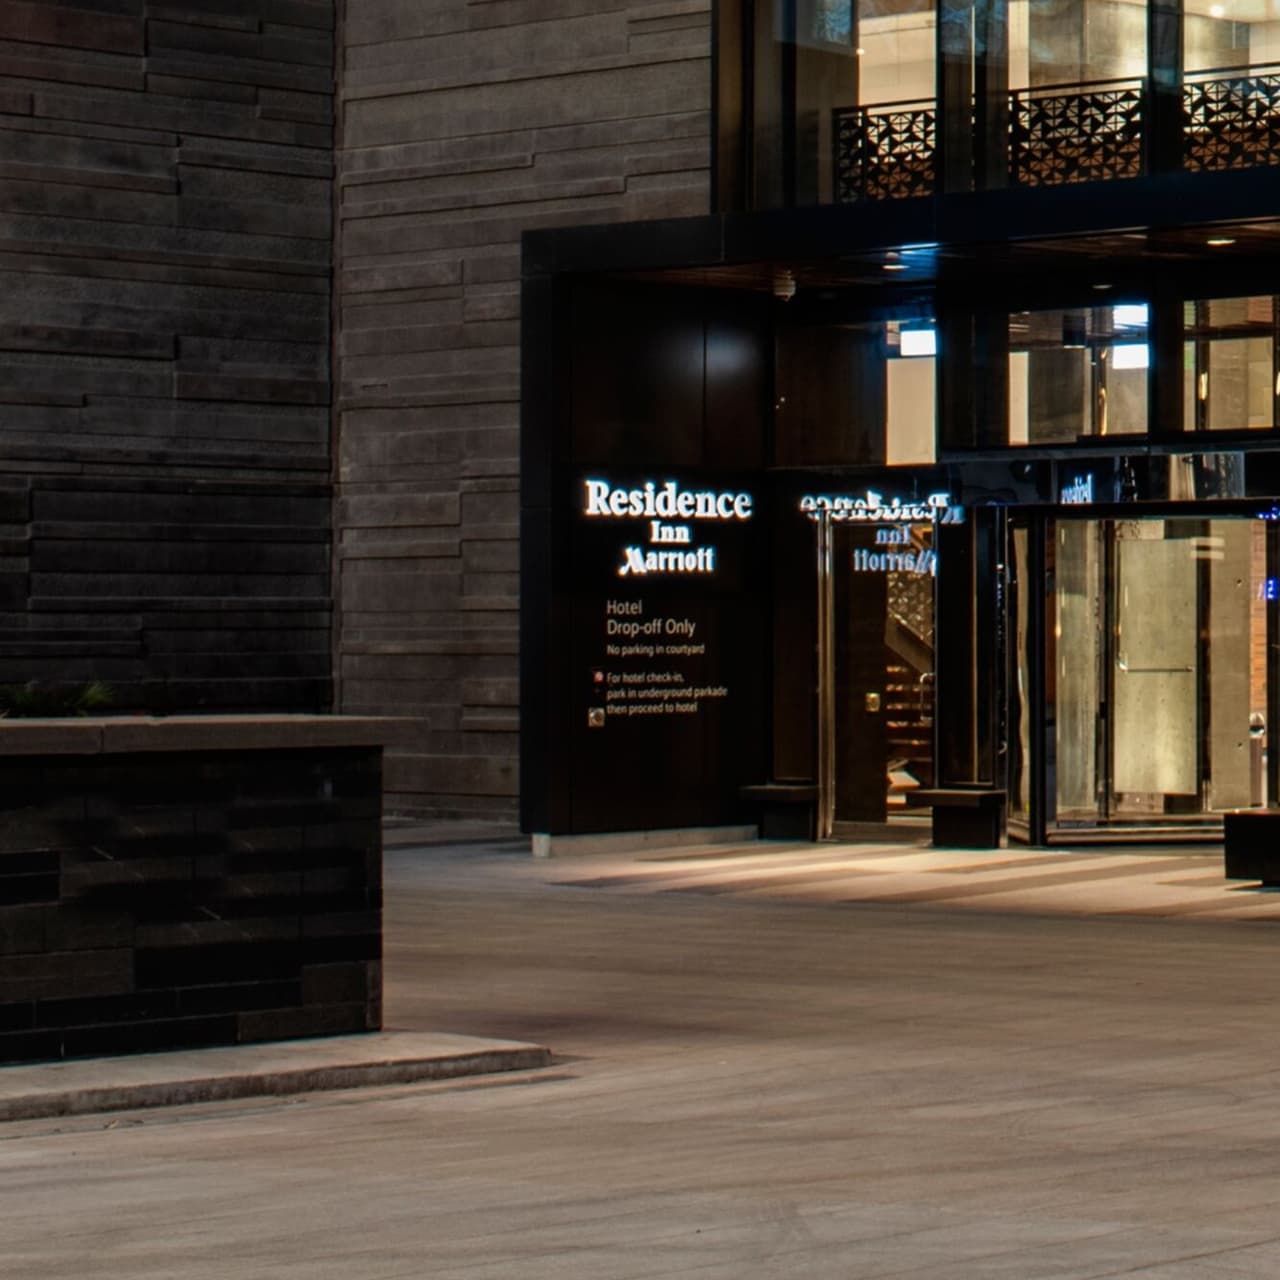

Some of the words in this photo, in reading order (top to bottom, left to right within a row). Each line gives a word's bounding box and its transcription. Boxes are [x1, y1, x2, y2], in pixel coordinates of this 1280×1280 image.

[585, 479, 752, 519] Residence
[651, 519, 691, 543] Inn
[617, 545, 714, 576] Marriott
[607, 600, 642, 615] Hotel
[607, 618, 662, 638] Drop-off
[665, 618, 696, 638] Only
[607, 644, 620, 655] No
[621, 644, 654, 657] parking
[655, 644, 665, 654] in
[665, 643, 705, 656] courtyard
[607, 672, 621, 684] For
[622, 672, 645, 683] hotel
[607, 688, 626, 700] park
[628, 688, 637, 698] in
[638, 686, 693, 700] underground
[694, 685, 728, 699] parkade
[607, 704, 627, 715] then
[628, 703, 664, 715] proceed
[665, 703, 675, 713] to
[675, 701, 698, 712] hotel
